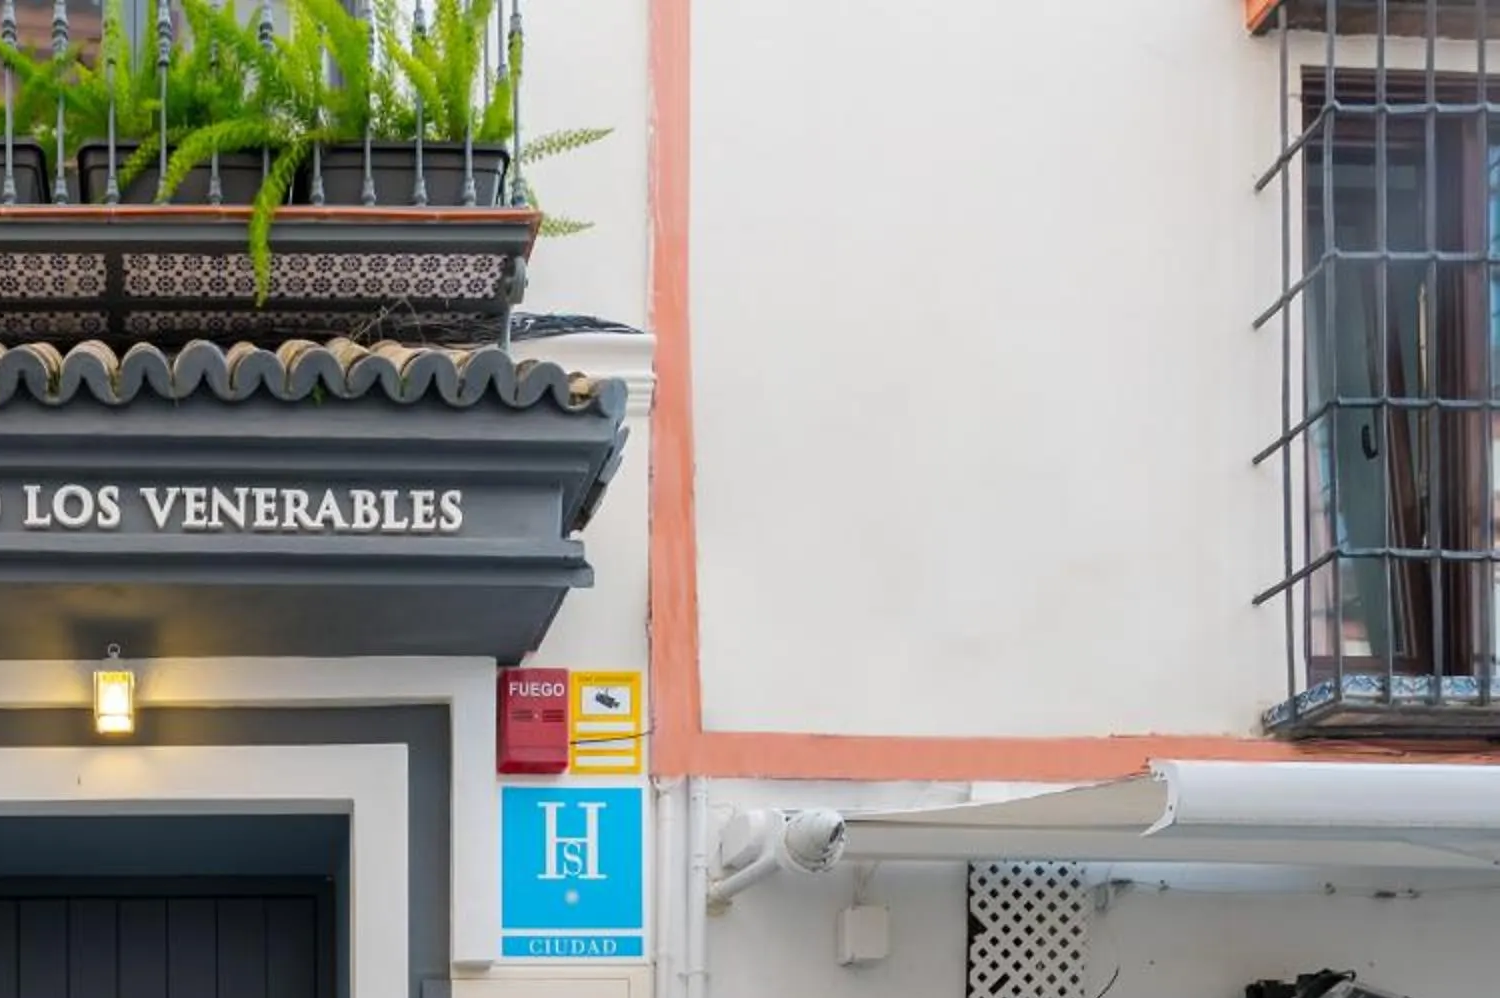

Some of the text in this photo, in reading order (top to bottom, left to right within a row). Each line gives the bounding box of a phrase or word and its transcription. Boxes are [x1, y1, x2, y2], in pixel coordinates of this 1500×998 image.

[23, 484, 121, 529] LOS
[139, 486, 463, 531] VENERABLES
[508, 681, 565, 697] FUEGO
[529, 939, 617, 955] CIUDAD
